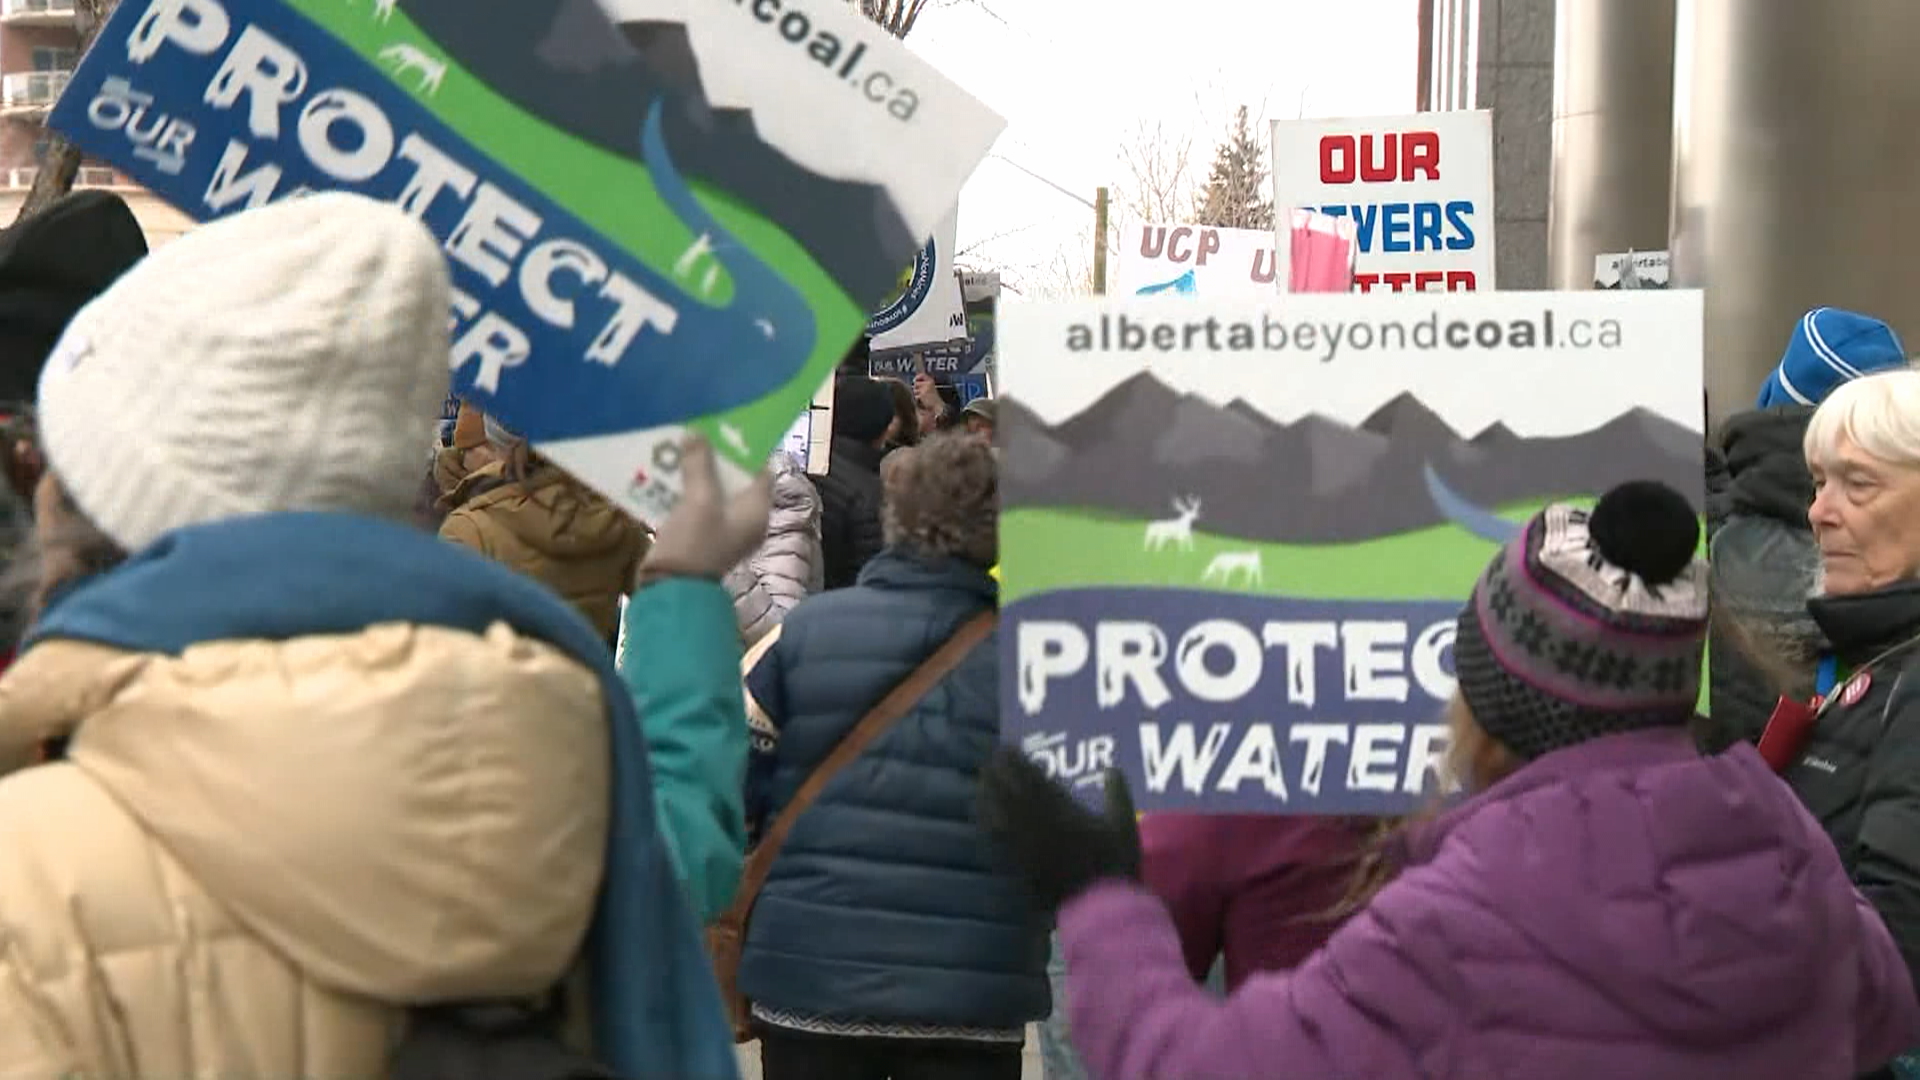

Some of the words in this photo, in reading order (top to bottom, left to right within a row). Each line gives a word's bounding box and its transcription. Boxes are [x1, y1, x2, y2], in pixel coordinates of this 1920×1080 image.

[87, 94, 196, 157] OUR
[126, 0, 678, 366] PROTECT
[1319, 131, 1440, 184] OUR
[1140, 226, 1220, 266] UCP
[1296, 200, 1476, 253] VERS
[1065, 309, 1623, 363] albertabeyondcoal.ca
[896, 356, 959, 373] WTER
[1017, 619, 1459, 714] PROTEC
[1139, 722, 1463, 803] WATER
